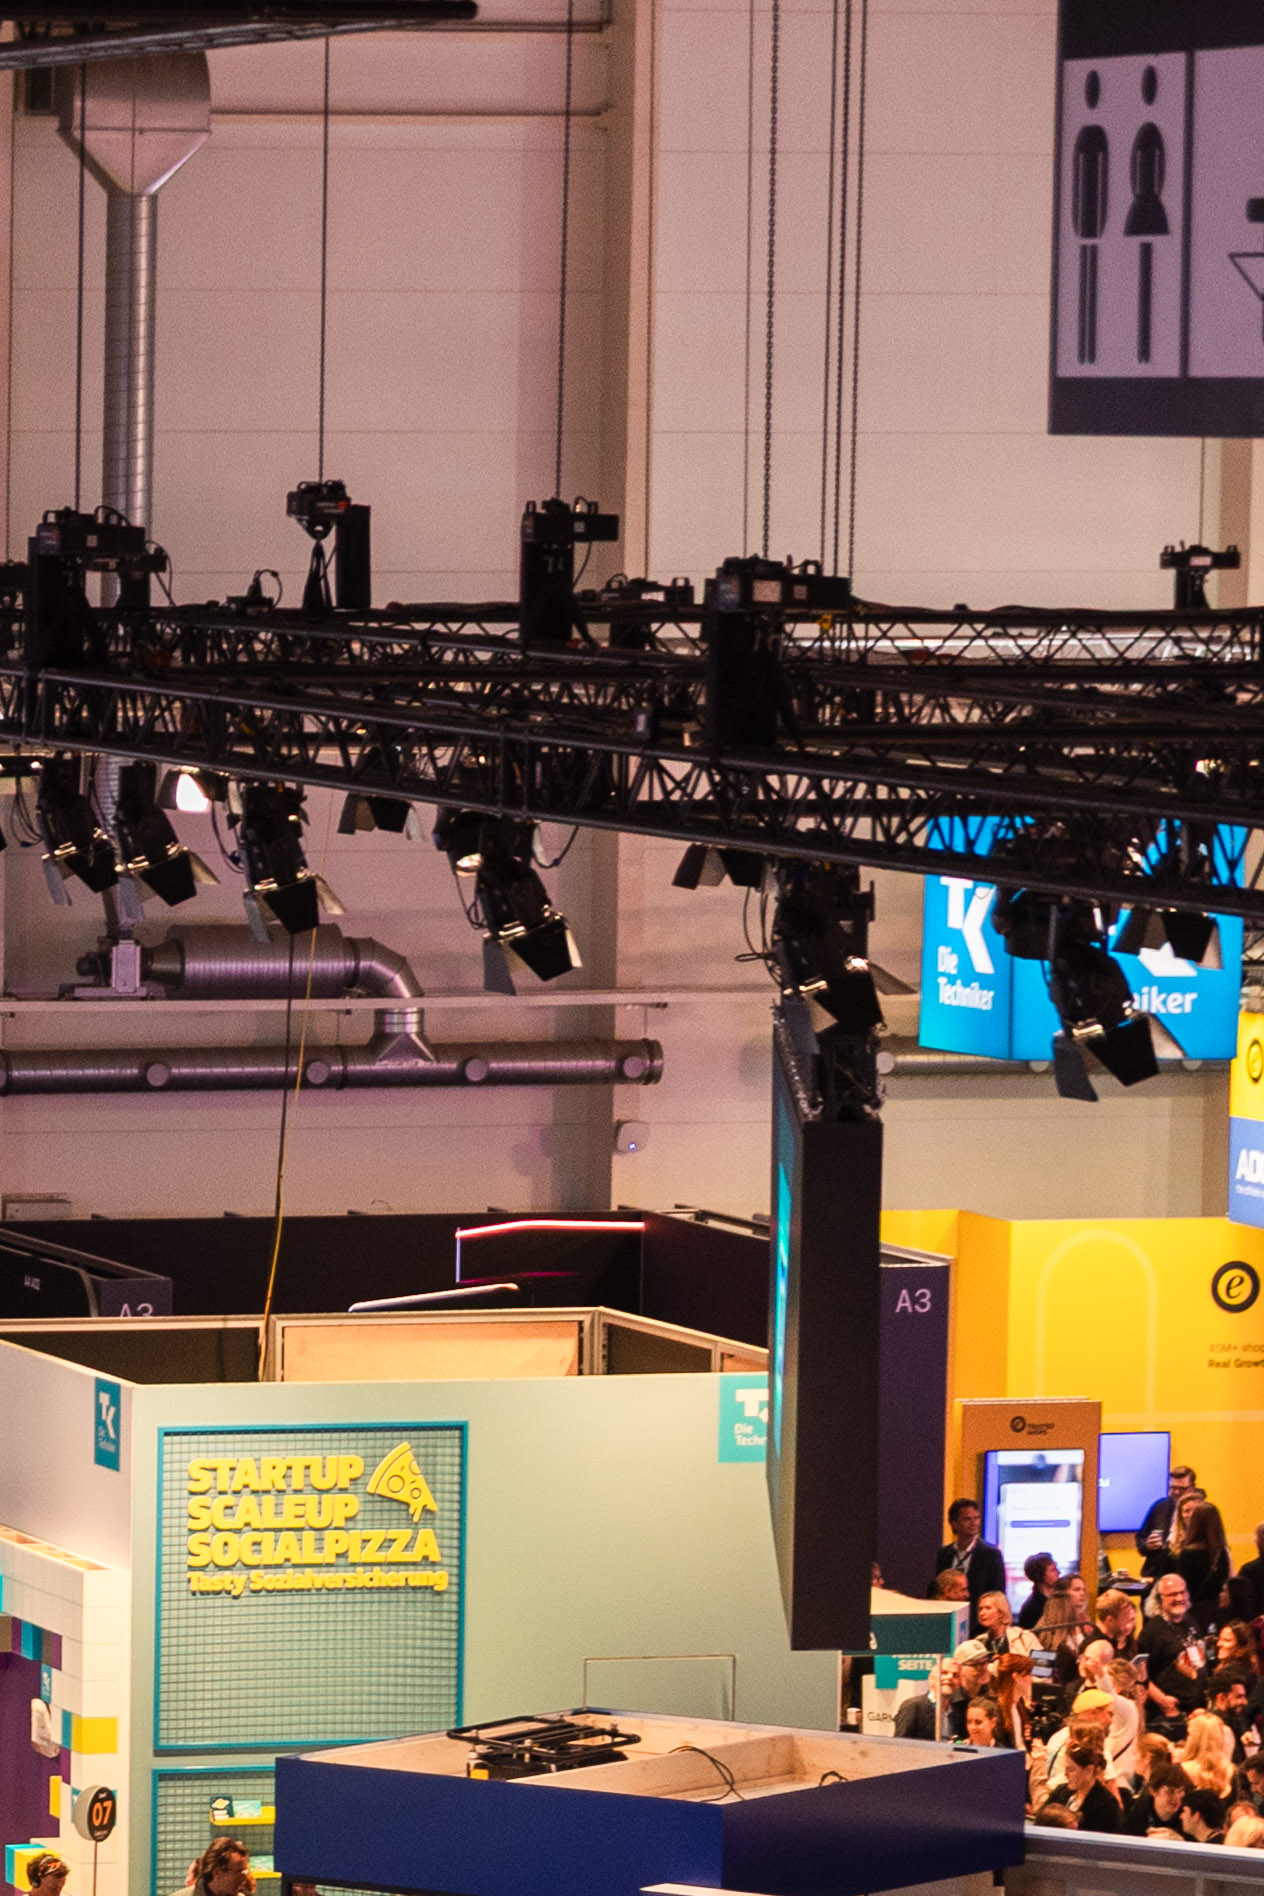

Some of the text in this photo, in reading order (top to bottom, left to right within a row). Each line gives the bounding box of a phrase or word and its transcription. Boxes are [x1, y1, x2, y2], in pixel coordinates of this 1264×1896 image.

[937, 946, 958, 975] Die
[938, 977, 996, 1011] Techniker
[895, 1289, 932, 1313] A3
[736, 1389, 768, 1424] T
[734, 1423, 754, 1434] Die
[187, 1455, 364, 1493] STARTUP
[187, 1494, 360, 1530] SCALEUP
[187, 1529, 442, 1567] SOCIALPIZZA
[188, 1567, 449, 1596] Tasty Sozialversicherung
[92, 1800, 113, 1827] 07
